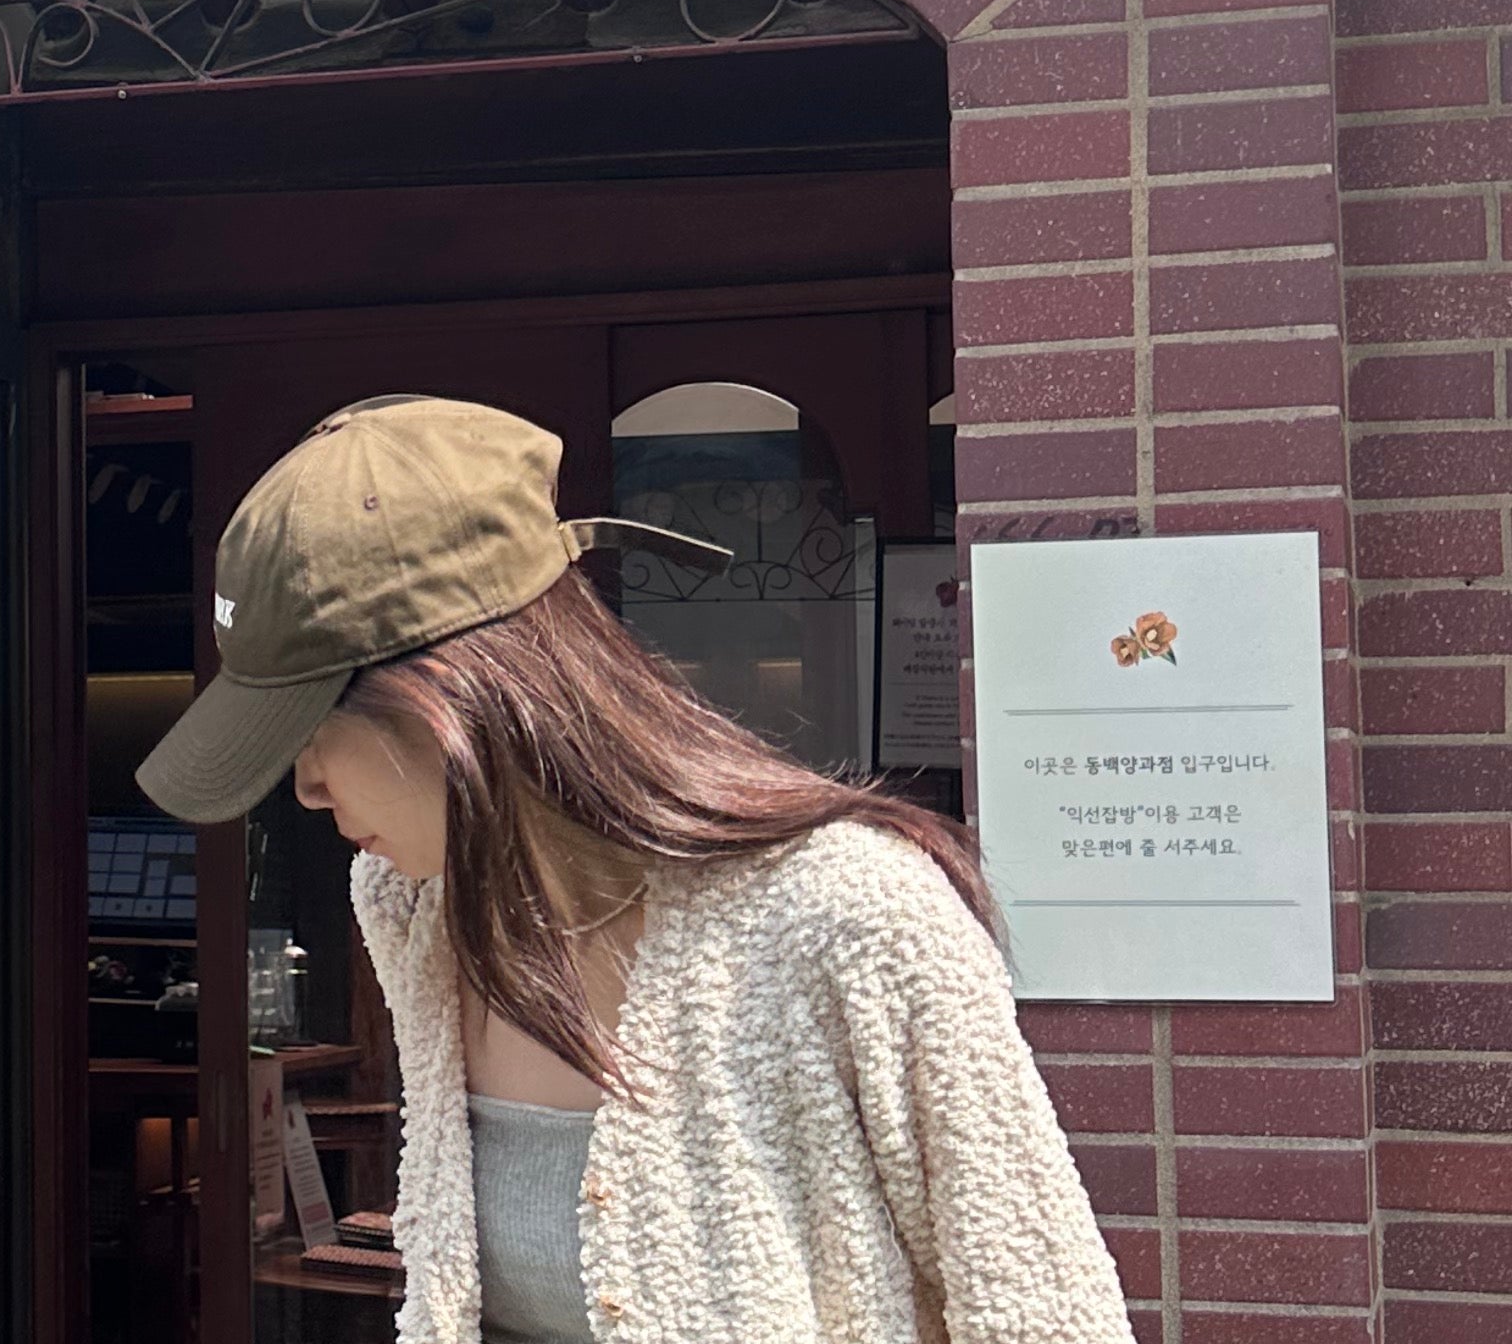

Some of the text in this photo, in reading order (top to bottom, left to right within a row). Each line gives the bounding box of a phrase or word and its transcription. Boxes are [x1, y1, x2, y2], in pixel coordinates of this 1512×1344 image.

[1024, 754, 1276, 776] 이곳은 동백양과점 입구입니다.
[1187, 804, 1242, 824] 고객은
[1062, 838, 1242, 858] 맞은편에 줄 서주세요.
